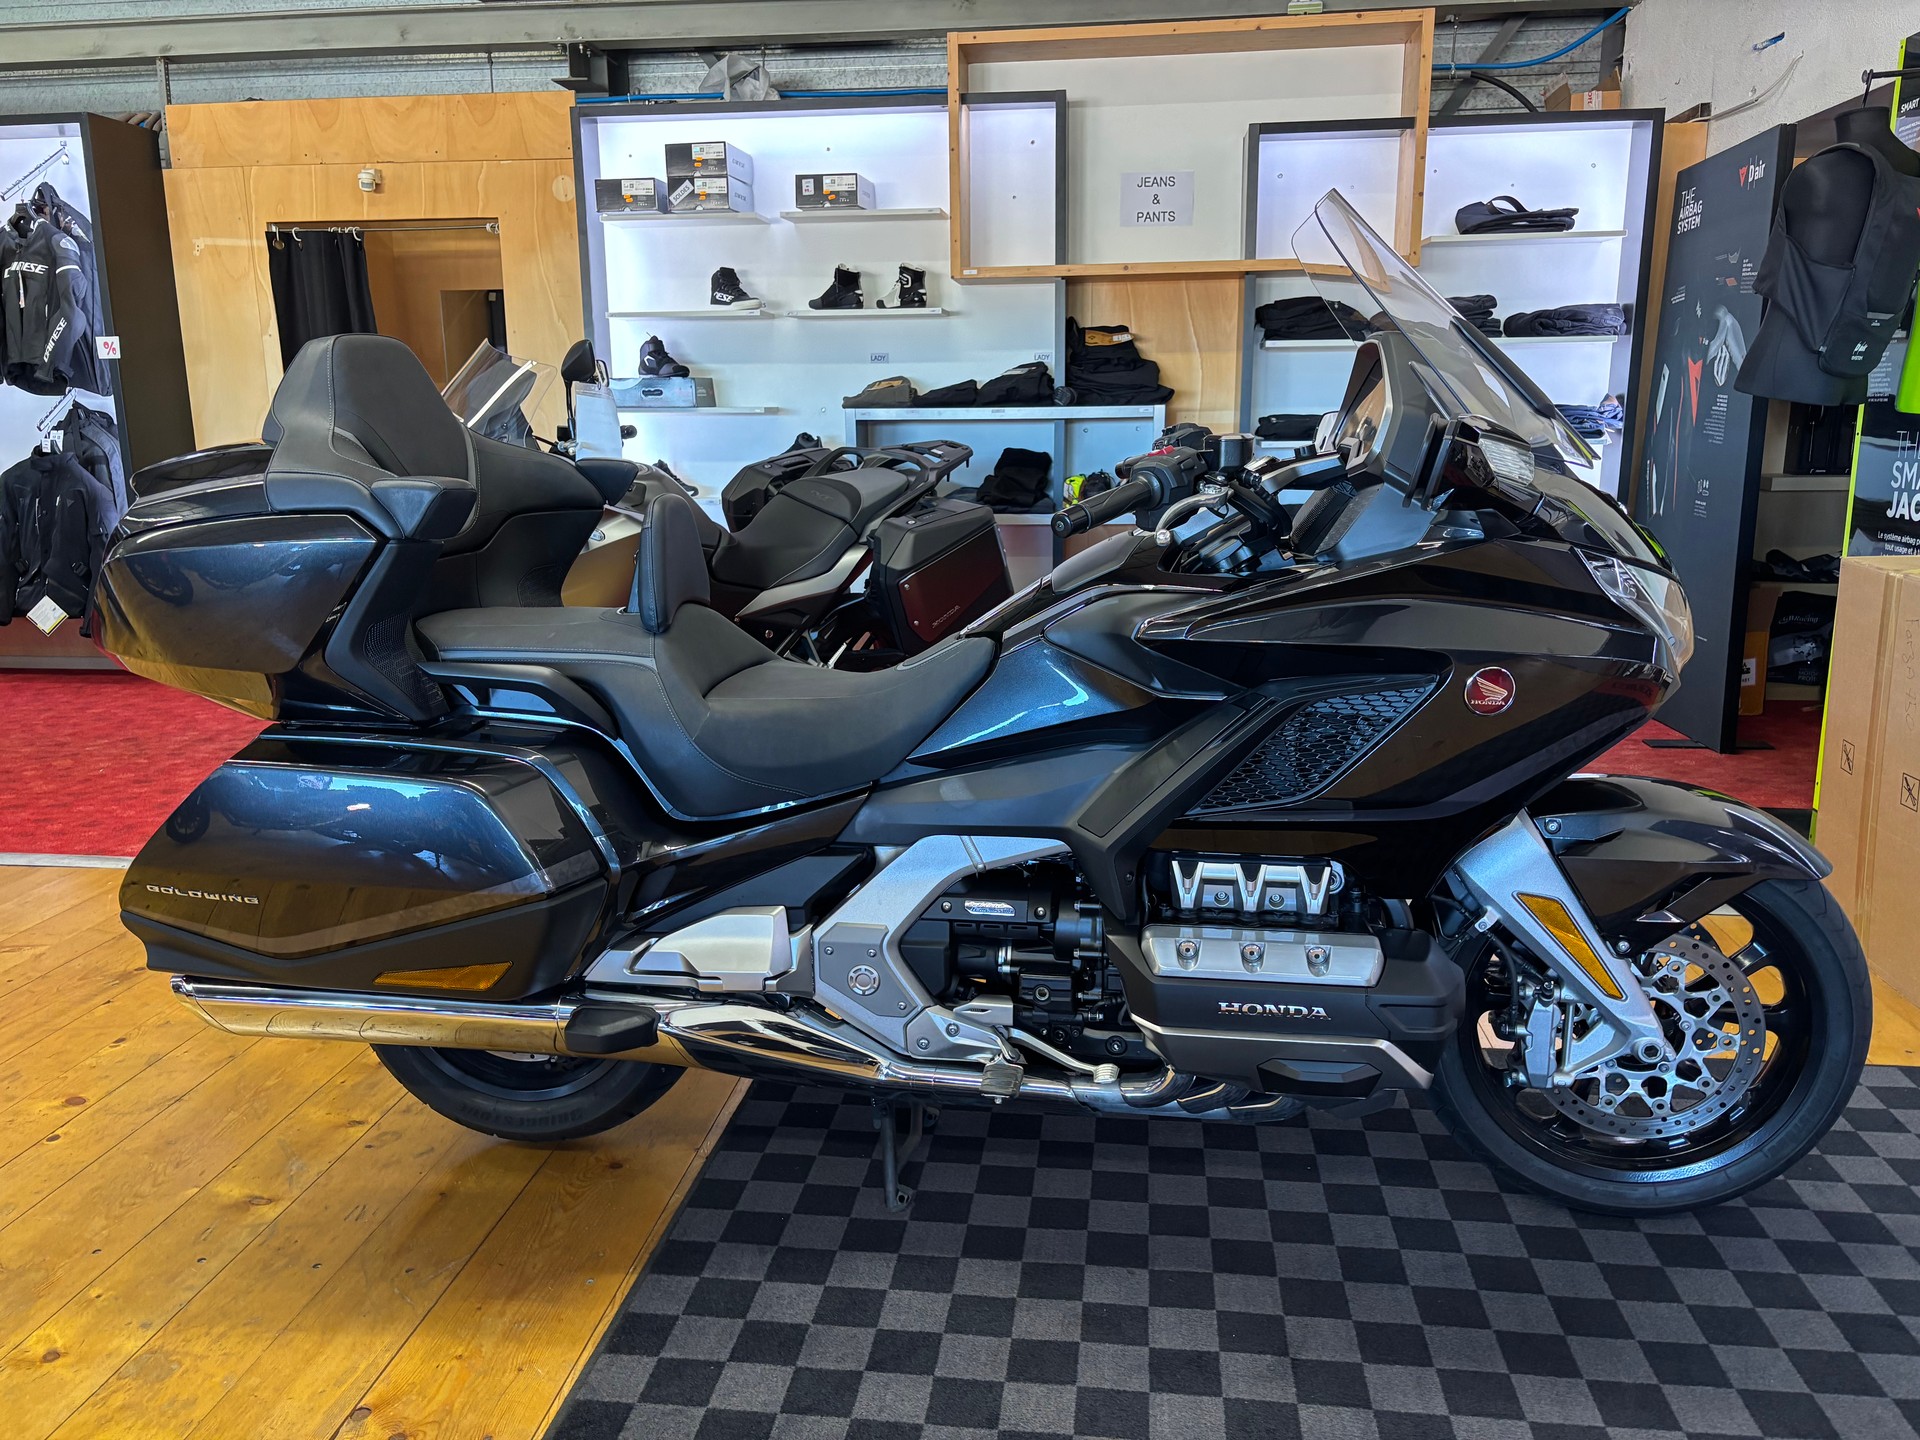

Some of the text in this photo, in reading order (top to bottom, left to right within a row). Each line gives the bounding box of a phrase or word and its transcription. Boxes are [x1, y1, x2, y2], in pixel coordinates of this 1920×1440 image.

[1136, 175, 1176, 188] JEANS
[672, 185, 690, 204] SOLDES
[1152, 193, 1161, 206] &
[1681, 186, 1697, 207] THE
[1136, 210, 1176, 223] PANTS
[1678, 200, 1703, 221] AIRBAG
[1677, 214, 1702, 235] SYSTEM
[43, 317, 68, 363] DAINESE
[870, 354, 886, 362] LADY
[1896, 430, 1920, 459] TH
[1878, 531, 1883, 539] Le
[1884, 533, 1901, 542] système
[1902, 535, 1915, 545] airbag
[1885, 543, 1894, 551] tout
[1894, 545, 1907, 554] usage
[146, 884, 259, 905] GOLDWING
[1217, 1001, 1332, 1021] HONDA
